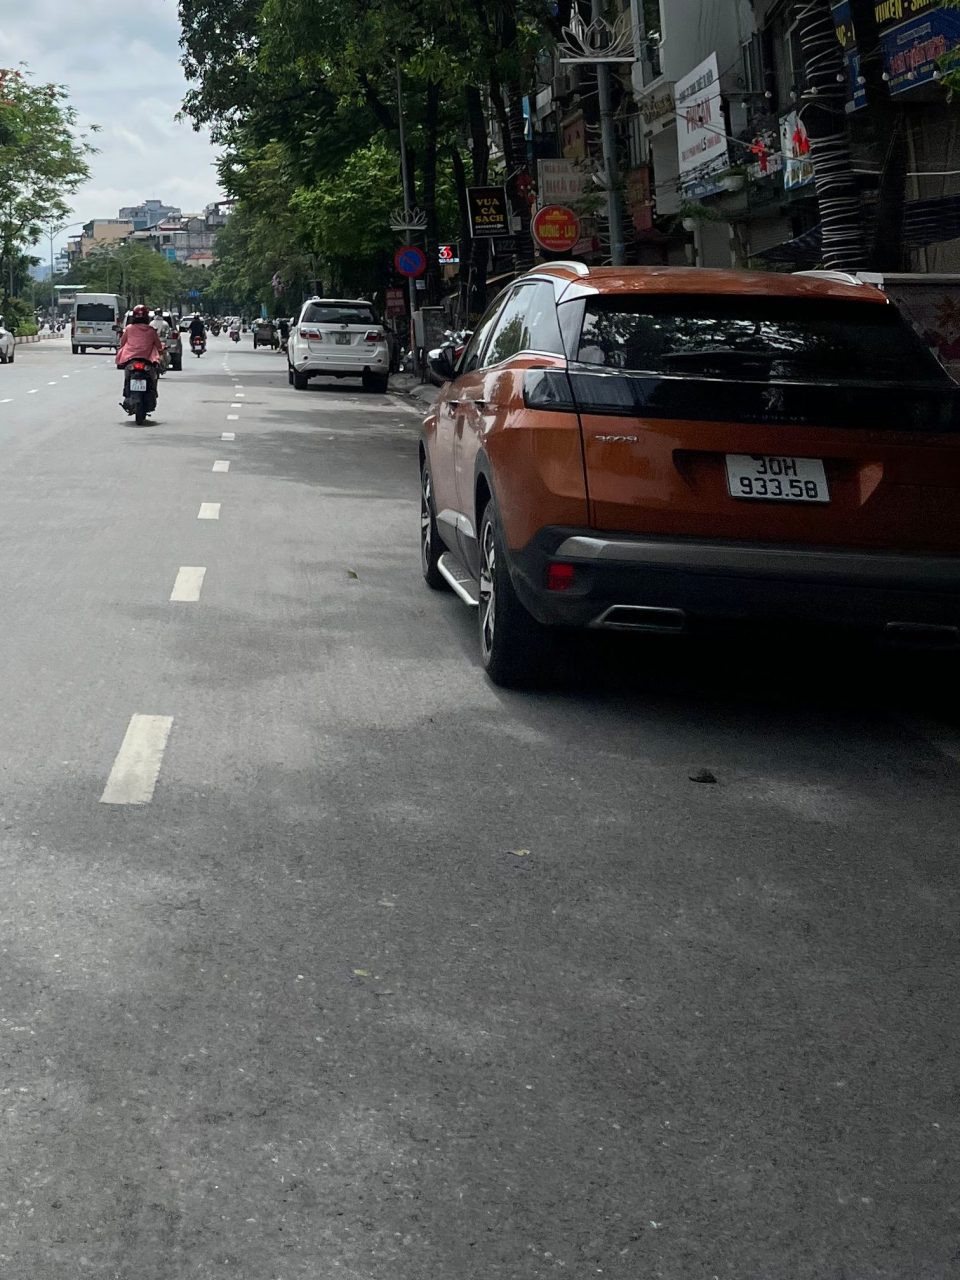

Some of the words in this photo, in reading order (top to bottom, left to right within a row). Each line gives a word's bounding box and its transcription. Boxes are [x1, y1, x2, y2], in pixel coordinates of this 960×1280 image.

[475, 198, 500, 206] VUA
[752, 457, 798, 477] 30H
[740, 476, 818, 499] 933.58
